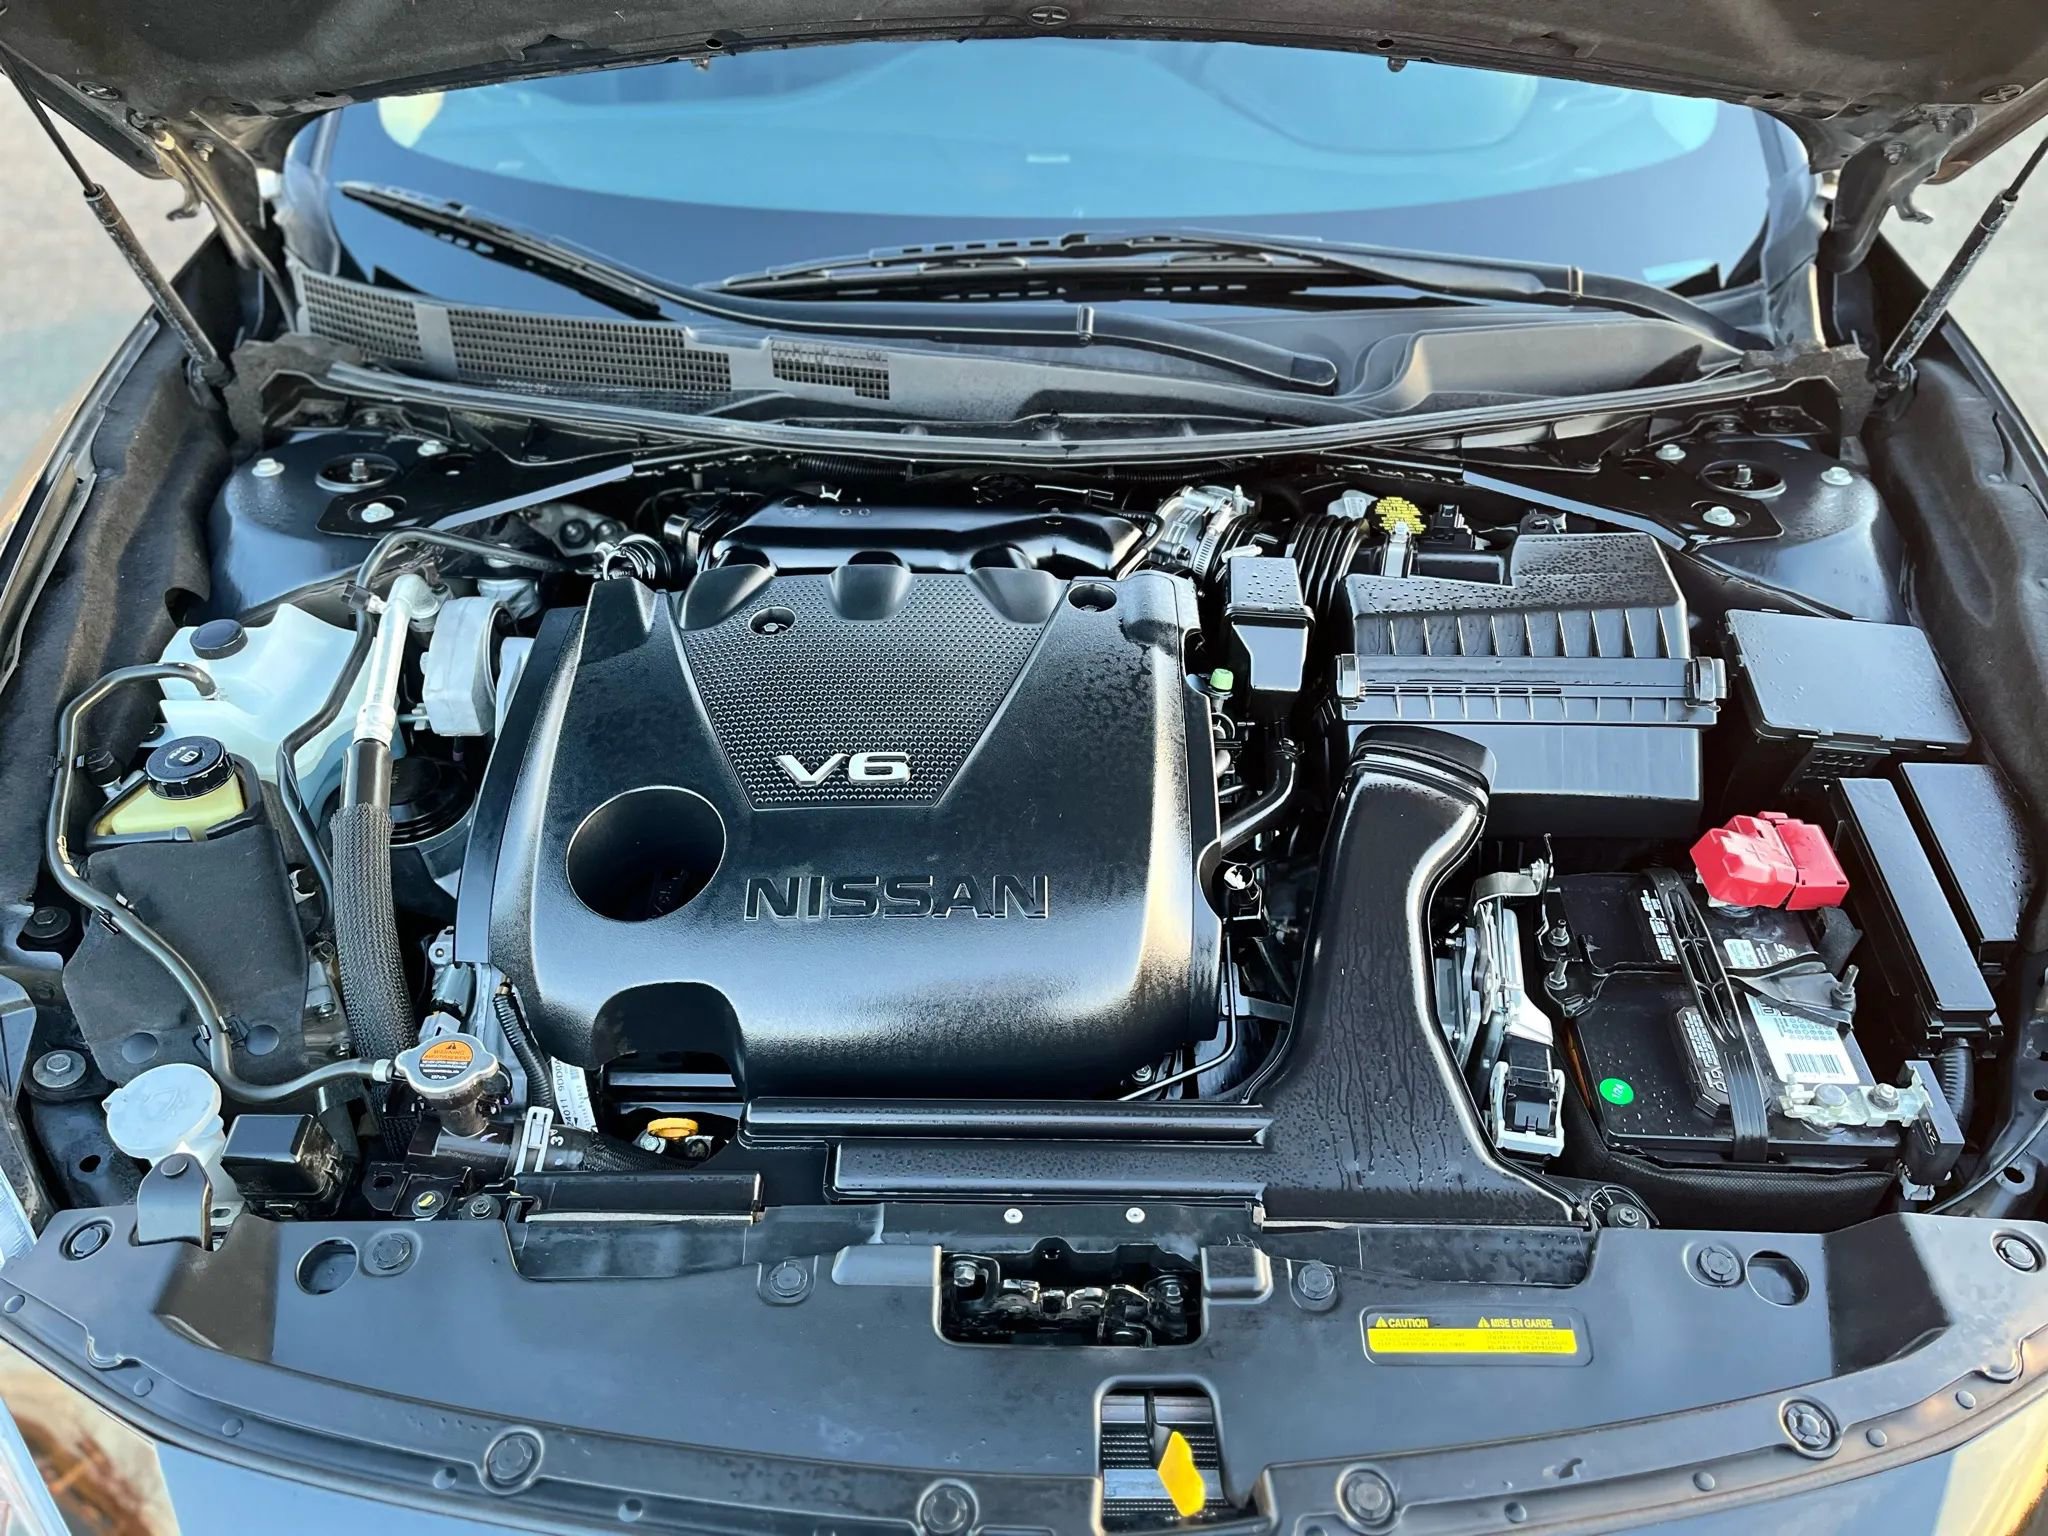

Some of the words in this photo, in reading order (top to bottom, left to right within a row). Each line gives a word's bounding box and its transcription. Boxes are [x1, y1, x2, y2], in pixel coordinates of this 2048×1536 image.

[774, 752, 911, 786] V6
[744, 875, 1048, 921] NISSAN
[1388, 1318, 1429, 1328] CAUTION
[1490, 1318, 1511, 1328] MISE
[1511, 1318, 1524, 1328] EN
[1524, 1318, 1554, 1329] GARDE
